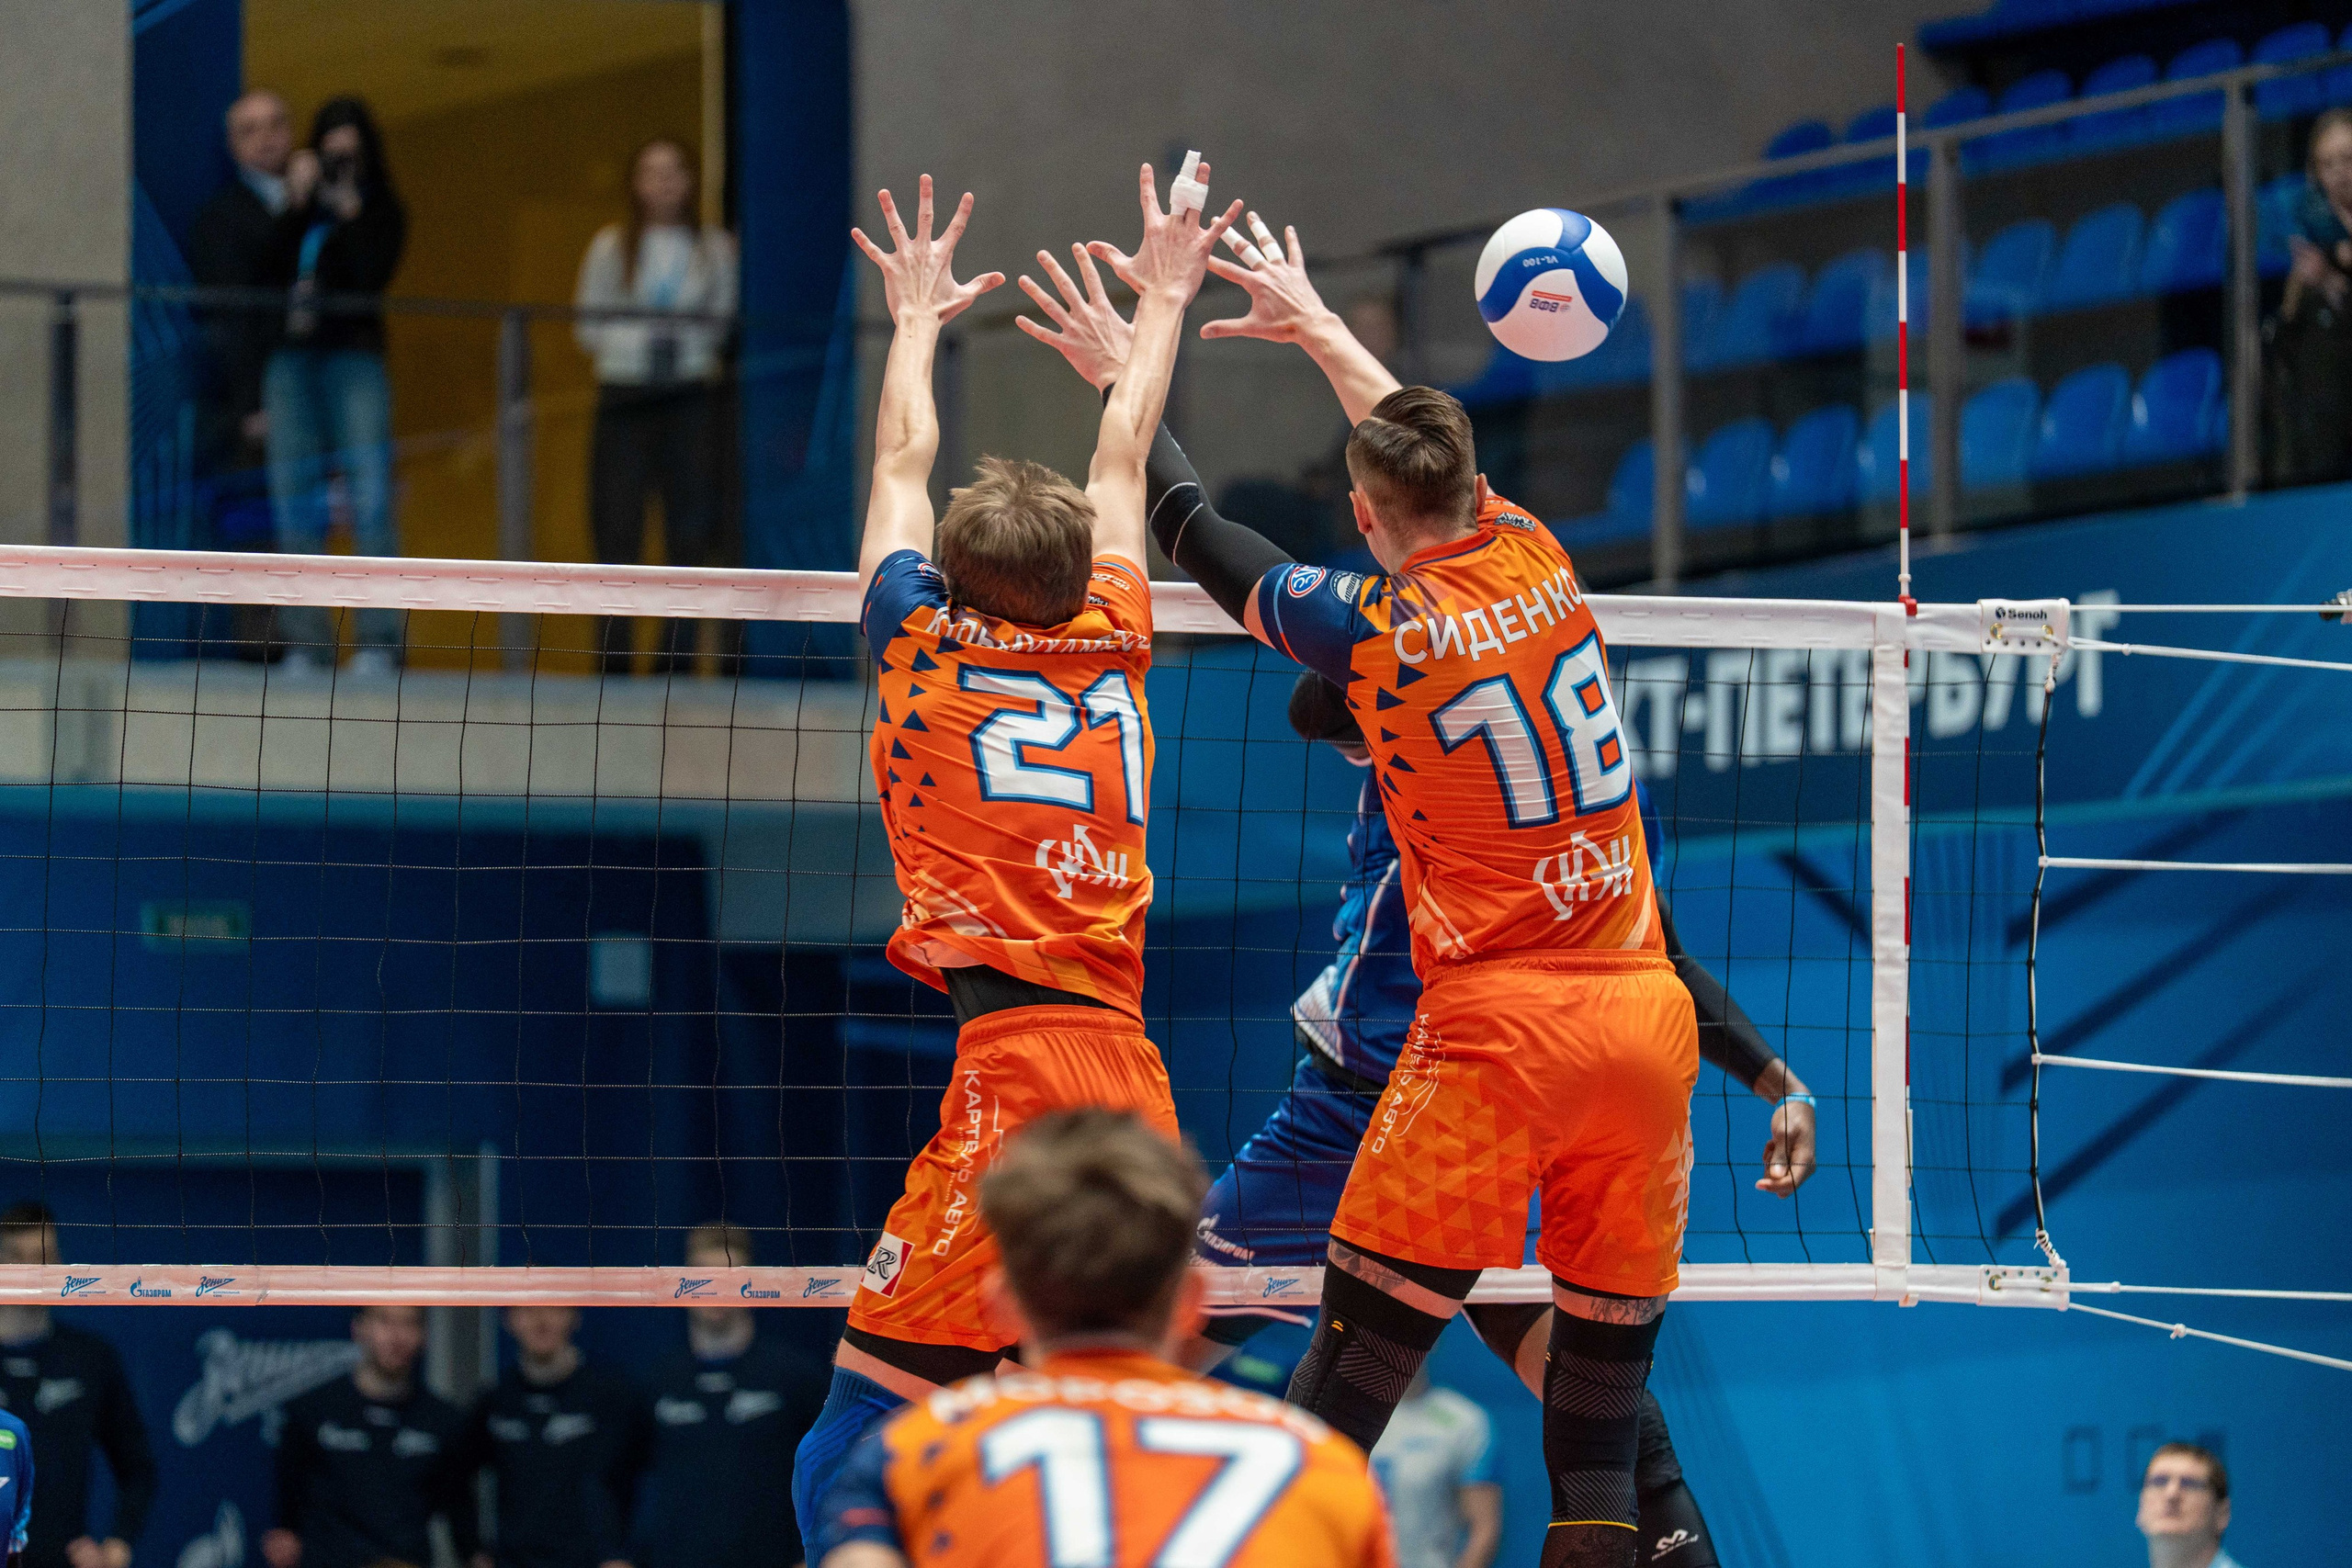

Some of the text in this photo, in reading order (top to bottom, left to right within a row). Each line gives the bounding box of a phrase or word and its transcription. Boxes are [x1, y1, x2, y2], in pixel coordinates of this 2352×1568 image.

[1394, 566, 1582, 664] СИДЕНКО
[2007, 608, 2047, 619] Senoh
[957, 662, 1144, 828] 21
[1428, 629, 1633, 829] 18
[1372, 1092, 1403, 1154] АВТО
[933, 1189, 967, 1257] АВТО
[980, 1405, 1304, 1568] 17
